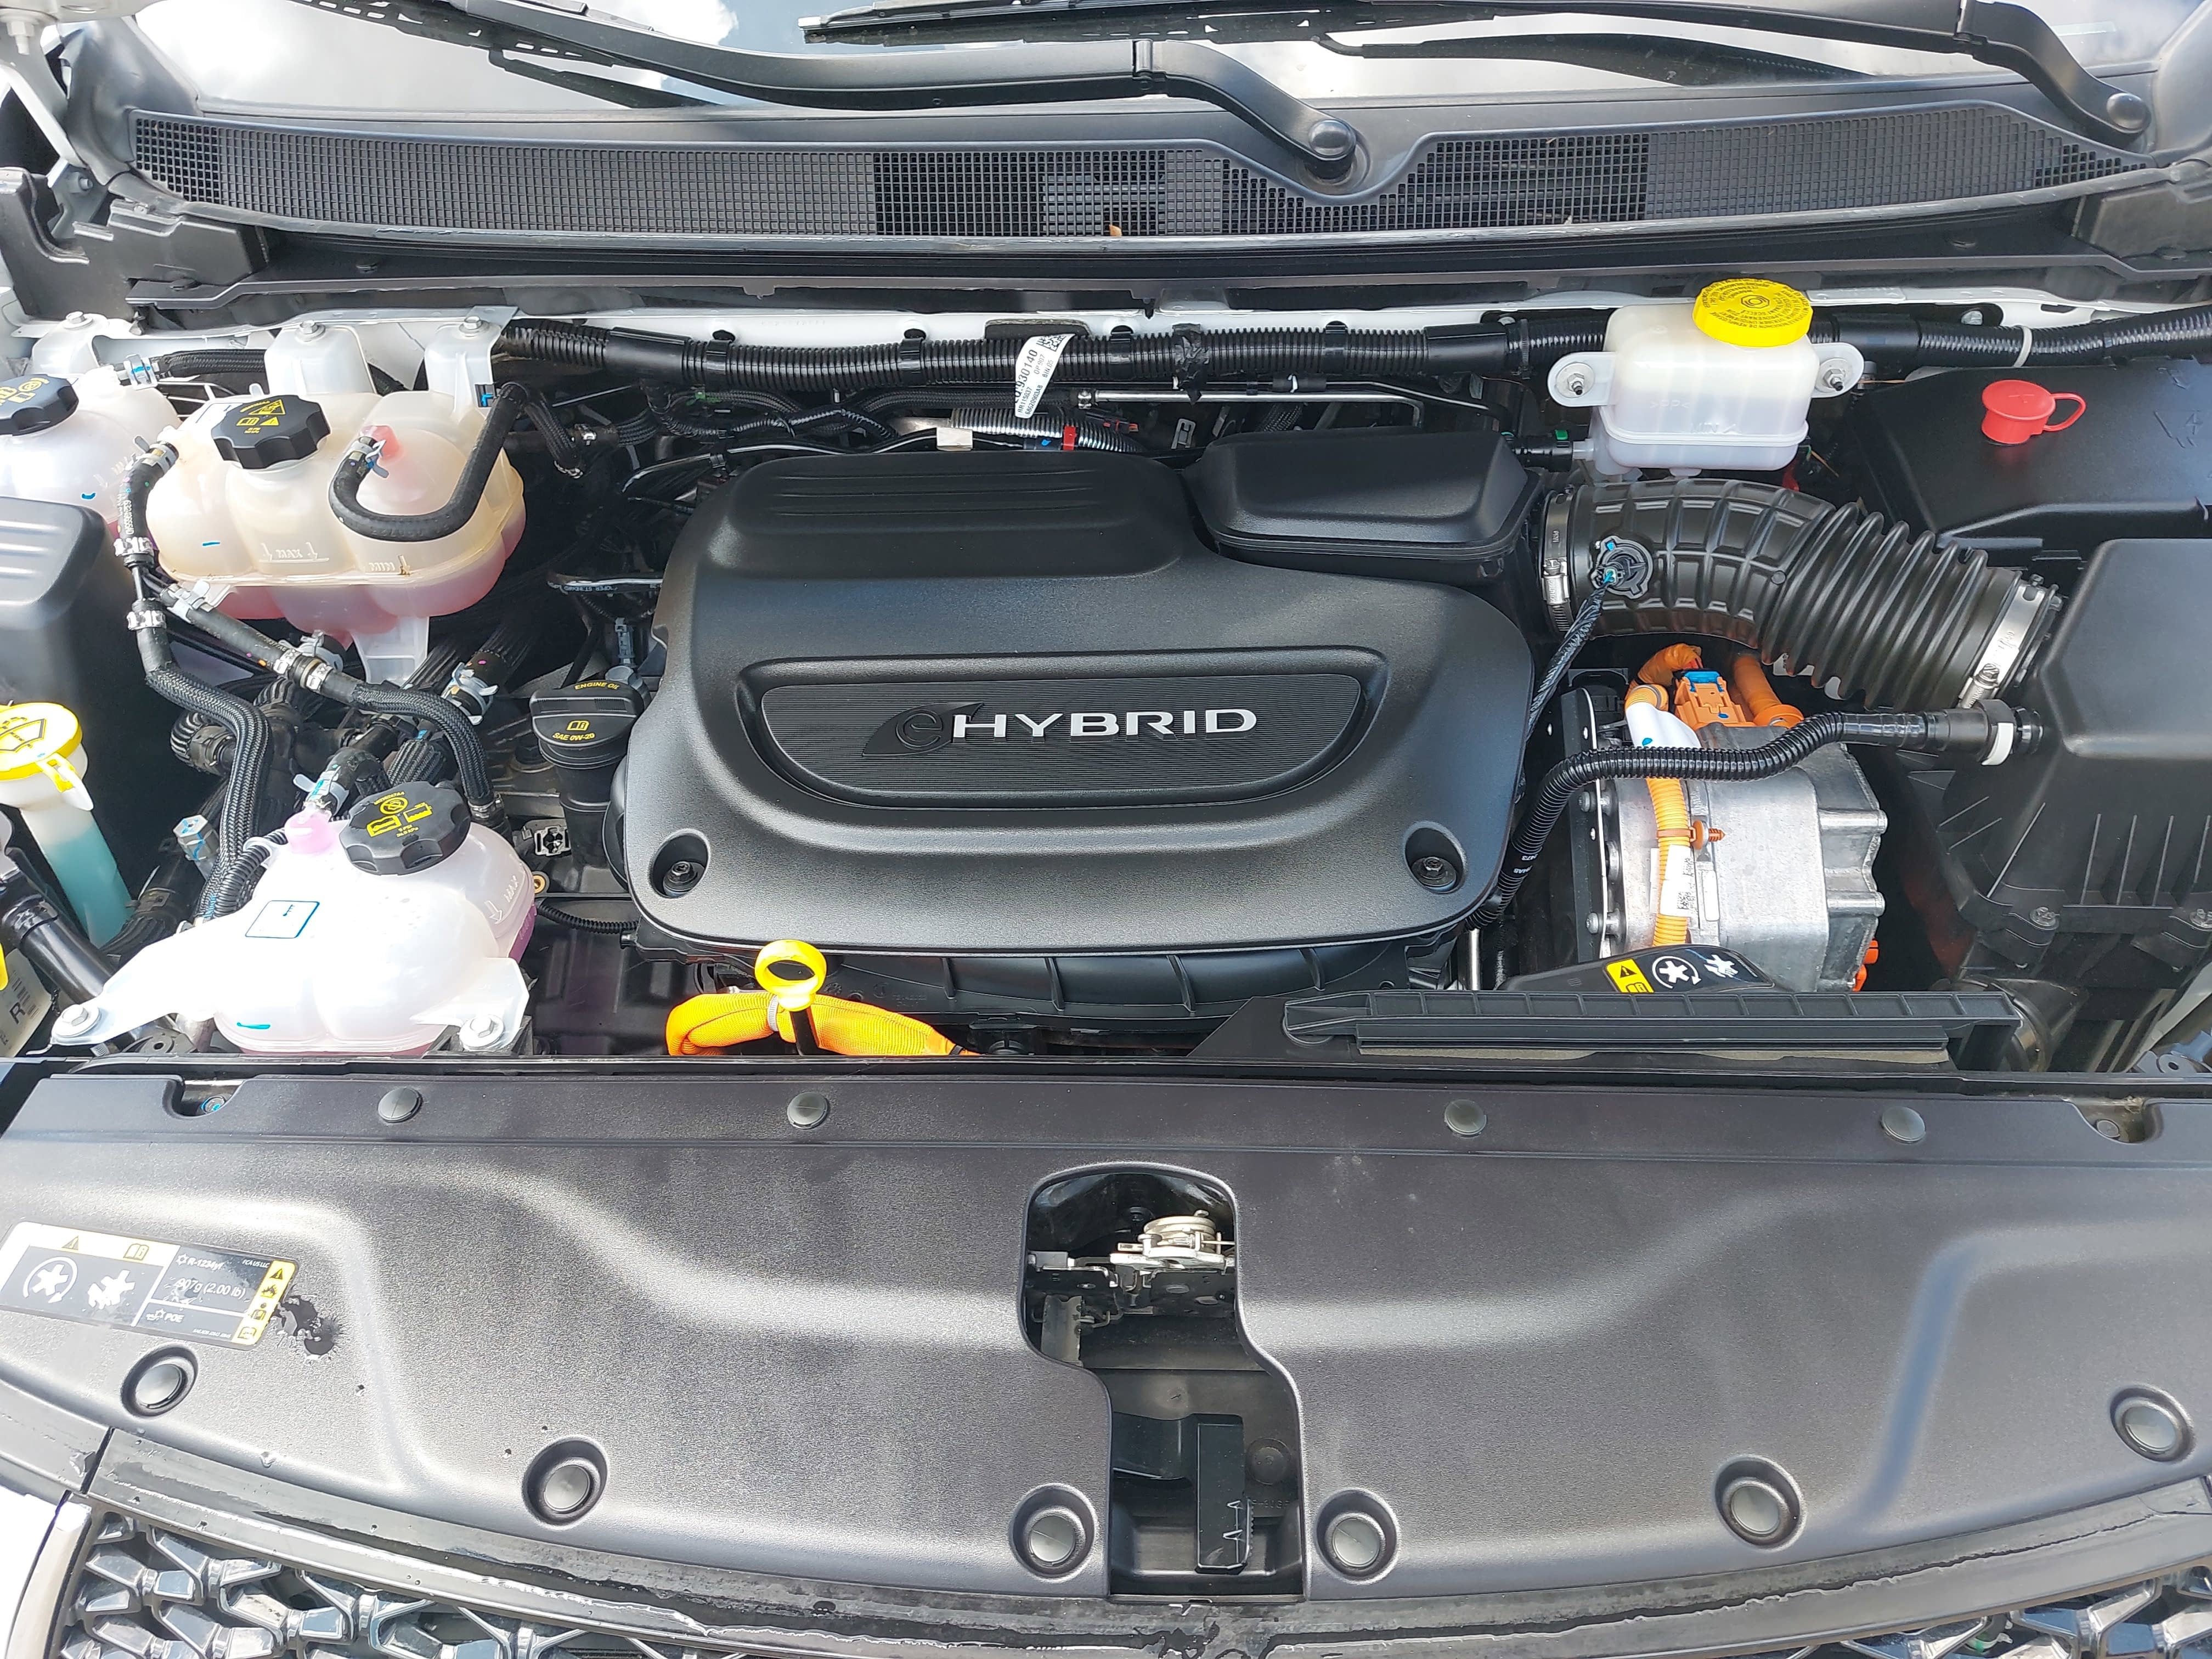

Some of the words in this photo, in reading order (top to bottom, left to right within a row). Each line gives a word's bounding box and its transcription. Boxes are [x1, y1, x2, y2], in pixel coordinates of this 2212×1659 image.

[952, 709, 1257, 742] HYBRID
[552, 732, 569, 741] SAE
[569, 732, 595, 741] 0W-20
[188, 1257, 224, 1270] R-1234yf
[203, 1282, 232, 1295] (2.00
[231, 1286, 246, 1299] lb)
[164, 1312, 185, 1323] POE
